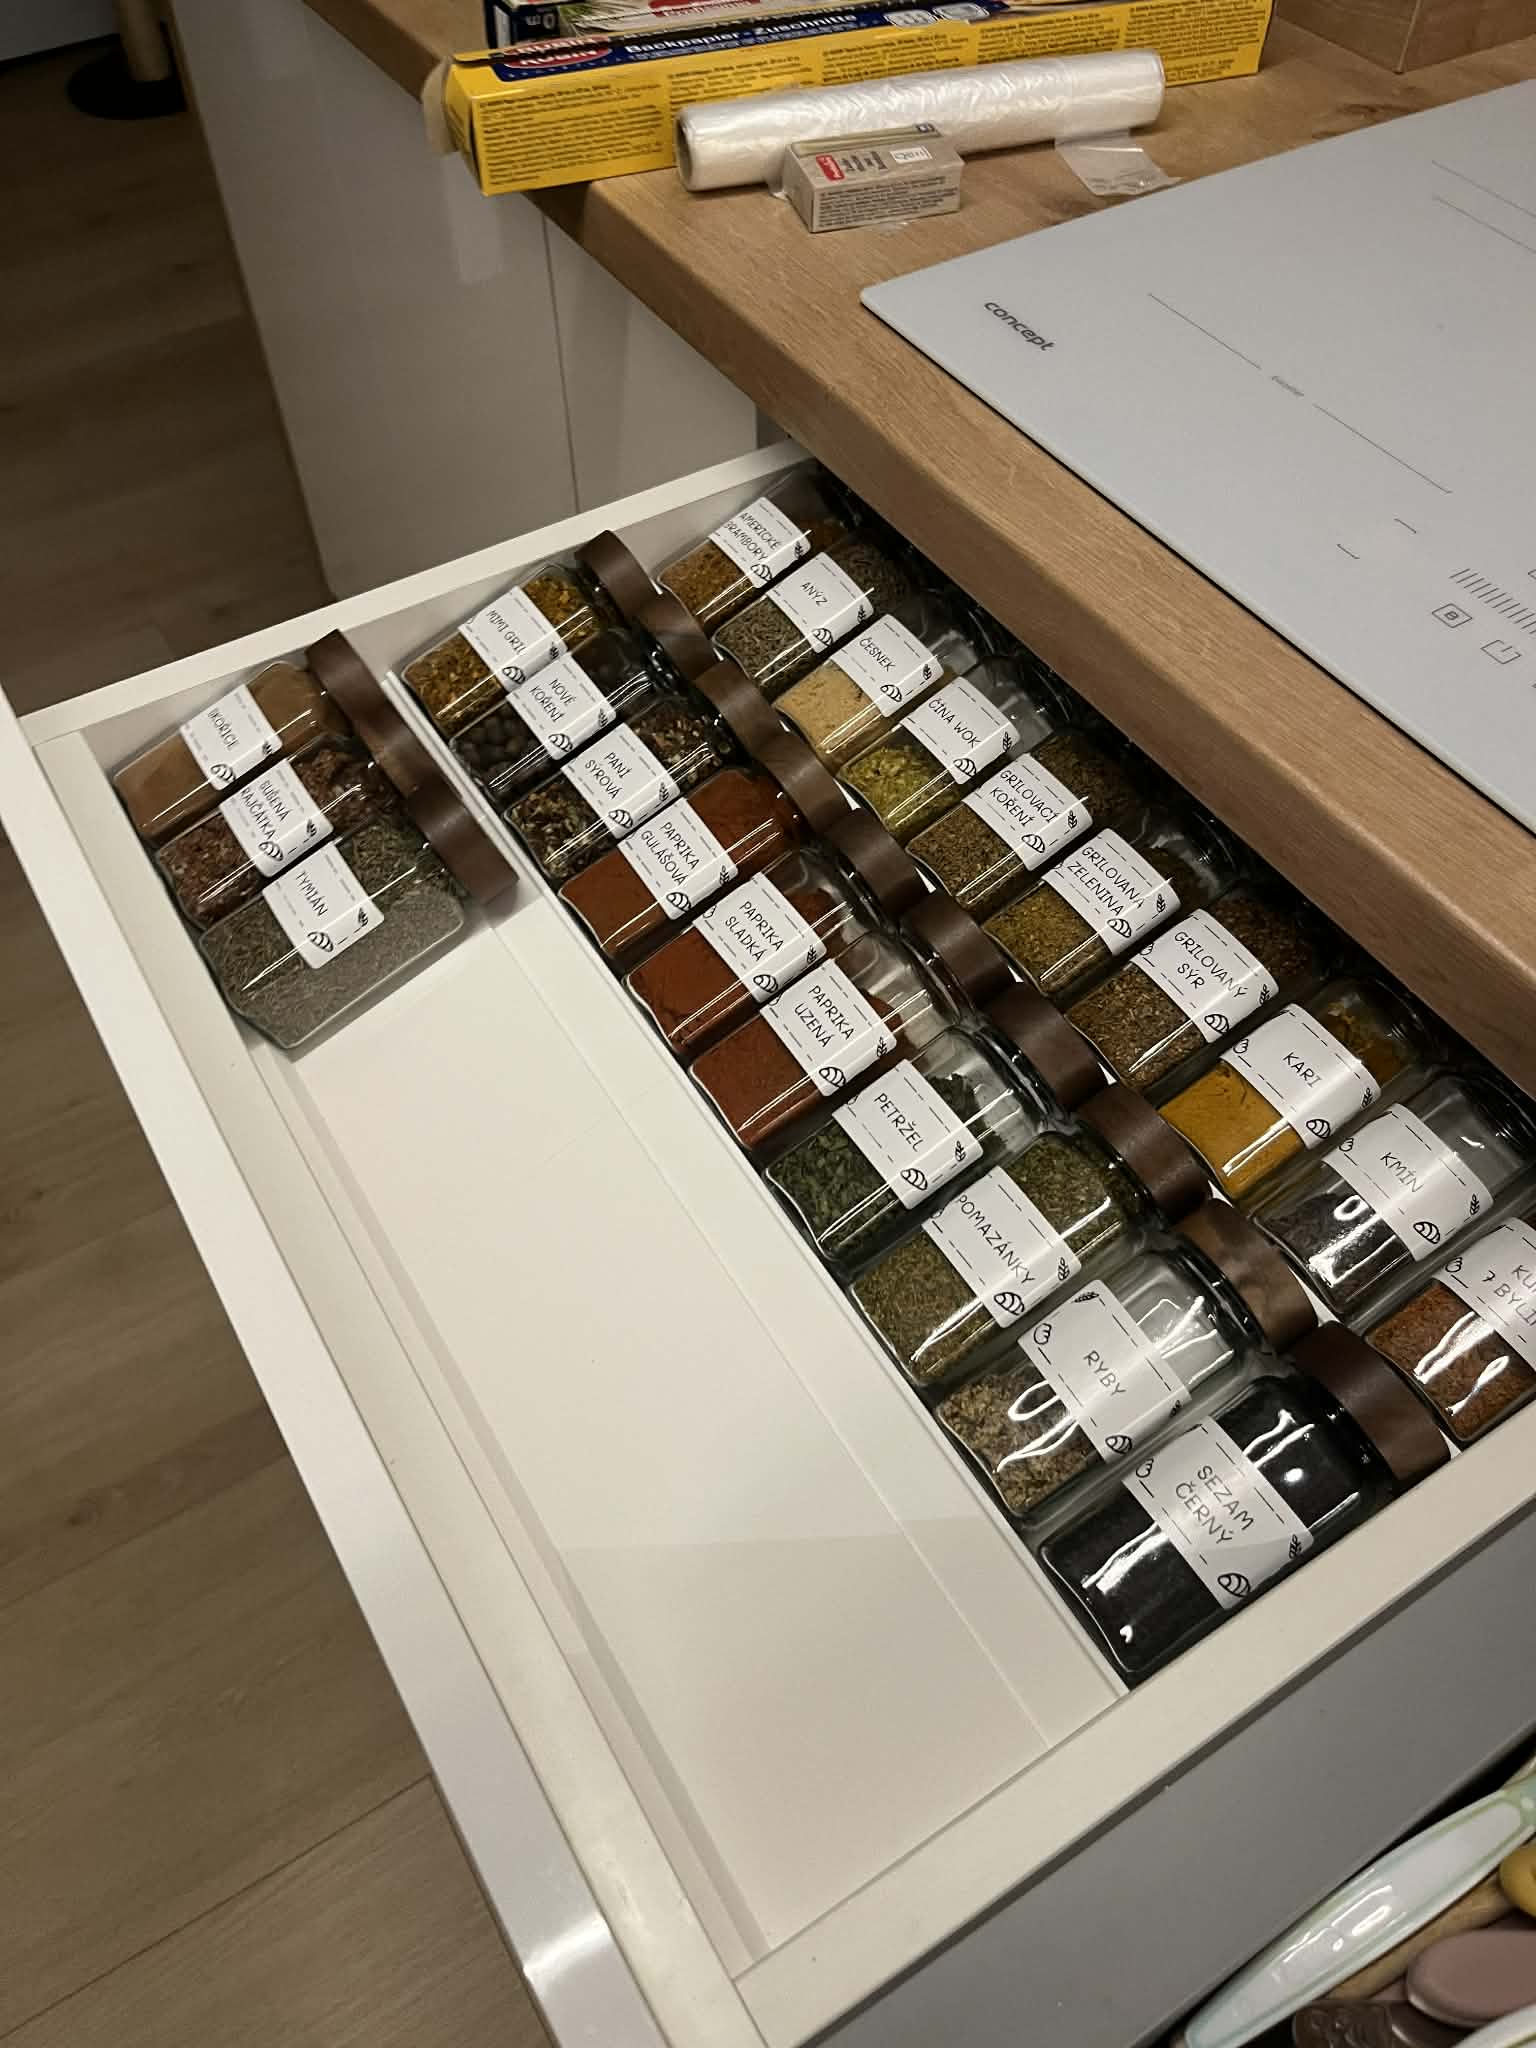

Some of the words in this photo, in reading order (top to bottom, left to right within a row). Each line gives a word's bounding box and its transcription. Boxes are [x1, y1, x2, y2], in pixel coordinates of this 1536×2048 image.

[984, 302, 1055, 351] concept
[724, 521, 768, 561] BRAMBORY
[740, 512, 781, 550] AMERICKÉ
[801, 580, 828, 606] ANÝZ
[486, 610, 509, 633] MIMI
[859, 636, 897, 673] ČESNEK
[529, 685, 566, 722] KOŘENÍ
[548, 678, 577, 707] NOVÉ
[953, 720, 981, 748] WOK
[604, 751, 632, 779] PANÍ
[260, 780, 293, 822] SUŠENÁ
[990, 786, 1035, 827] KOŘENÍ
[1000, 769, 1060, 824] GRILOVACÍ
[641, 830, 688, 886] GULÁŠOVÁ
[660, 821, 700, 870] PAPRIKA
[296, 870, 328, 917] TYMIÁN
[1067, 861, 1125, 916] ZELENINA
[725, 915, 768, 962] SLADKÁ
[739, 901, 784, 951] PAPRIKA
[1177, 960, 1205, 989] SÝR
[794, 1002, 836, 1047] UZENÁ
[808, 985, 855, 1040] PAPRIKA
[1283, 1051, 1322, 1088] KARI
[874, 1092, 924, 1152] PETRŽEL
[1380, 1151, 1424, 1193] KMÍN
[957, 1194, 1036, 1284] POMAZÁNKY
[1482, 1269, 1496, 1282] 7
[1494, 1283, 1536, 1327] BYLI
[1512, 1264, 1536, 1293] KU
[1083, 1350, 1127, 1397] RYBY
[1175, 1480, 1235, 1545] ČERNÝ
[1197, 1465, 1254, 1530] SEZAM
